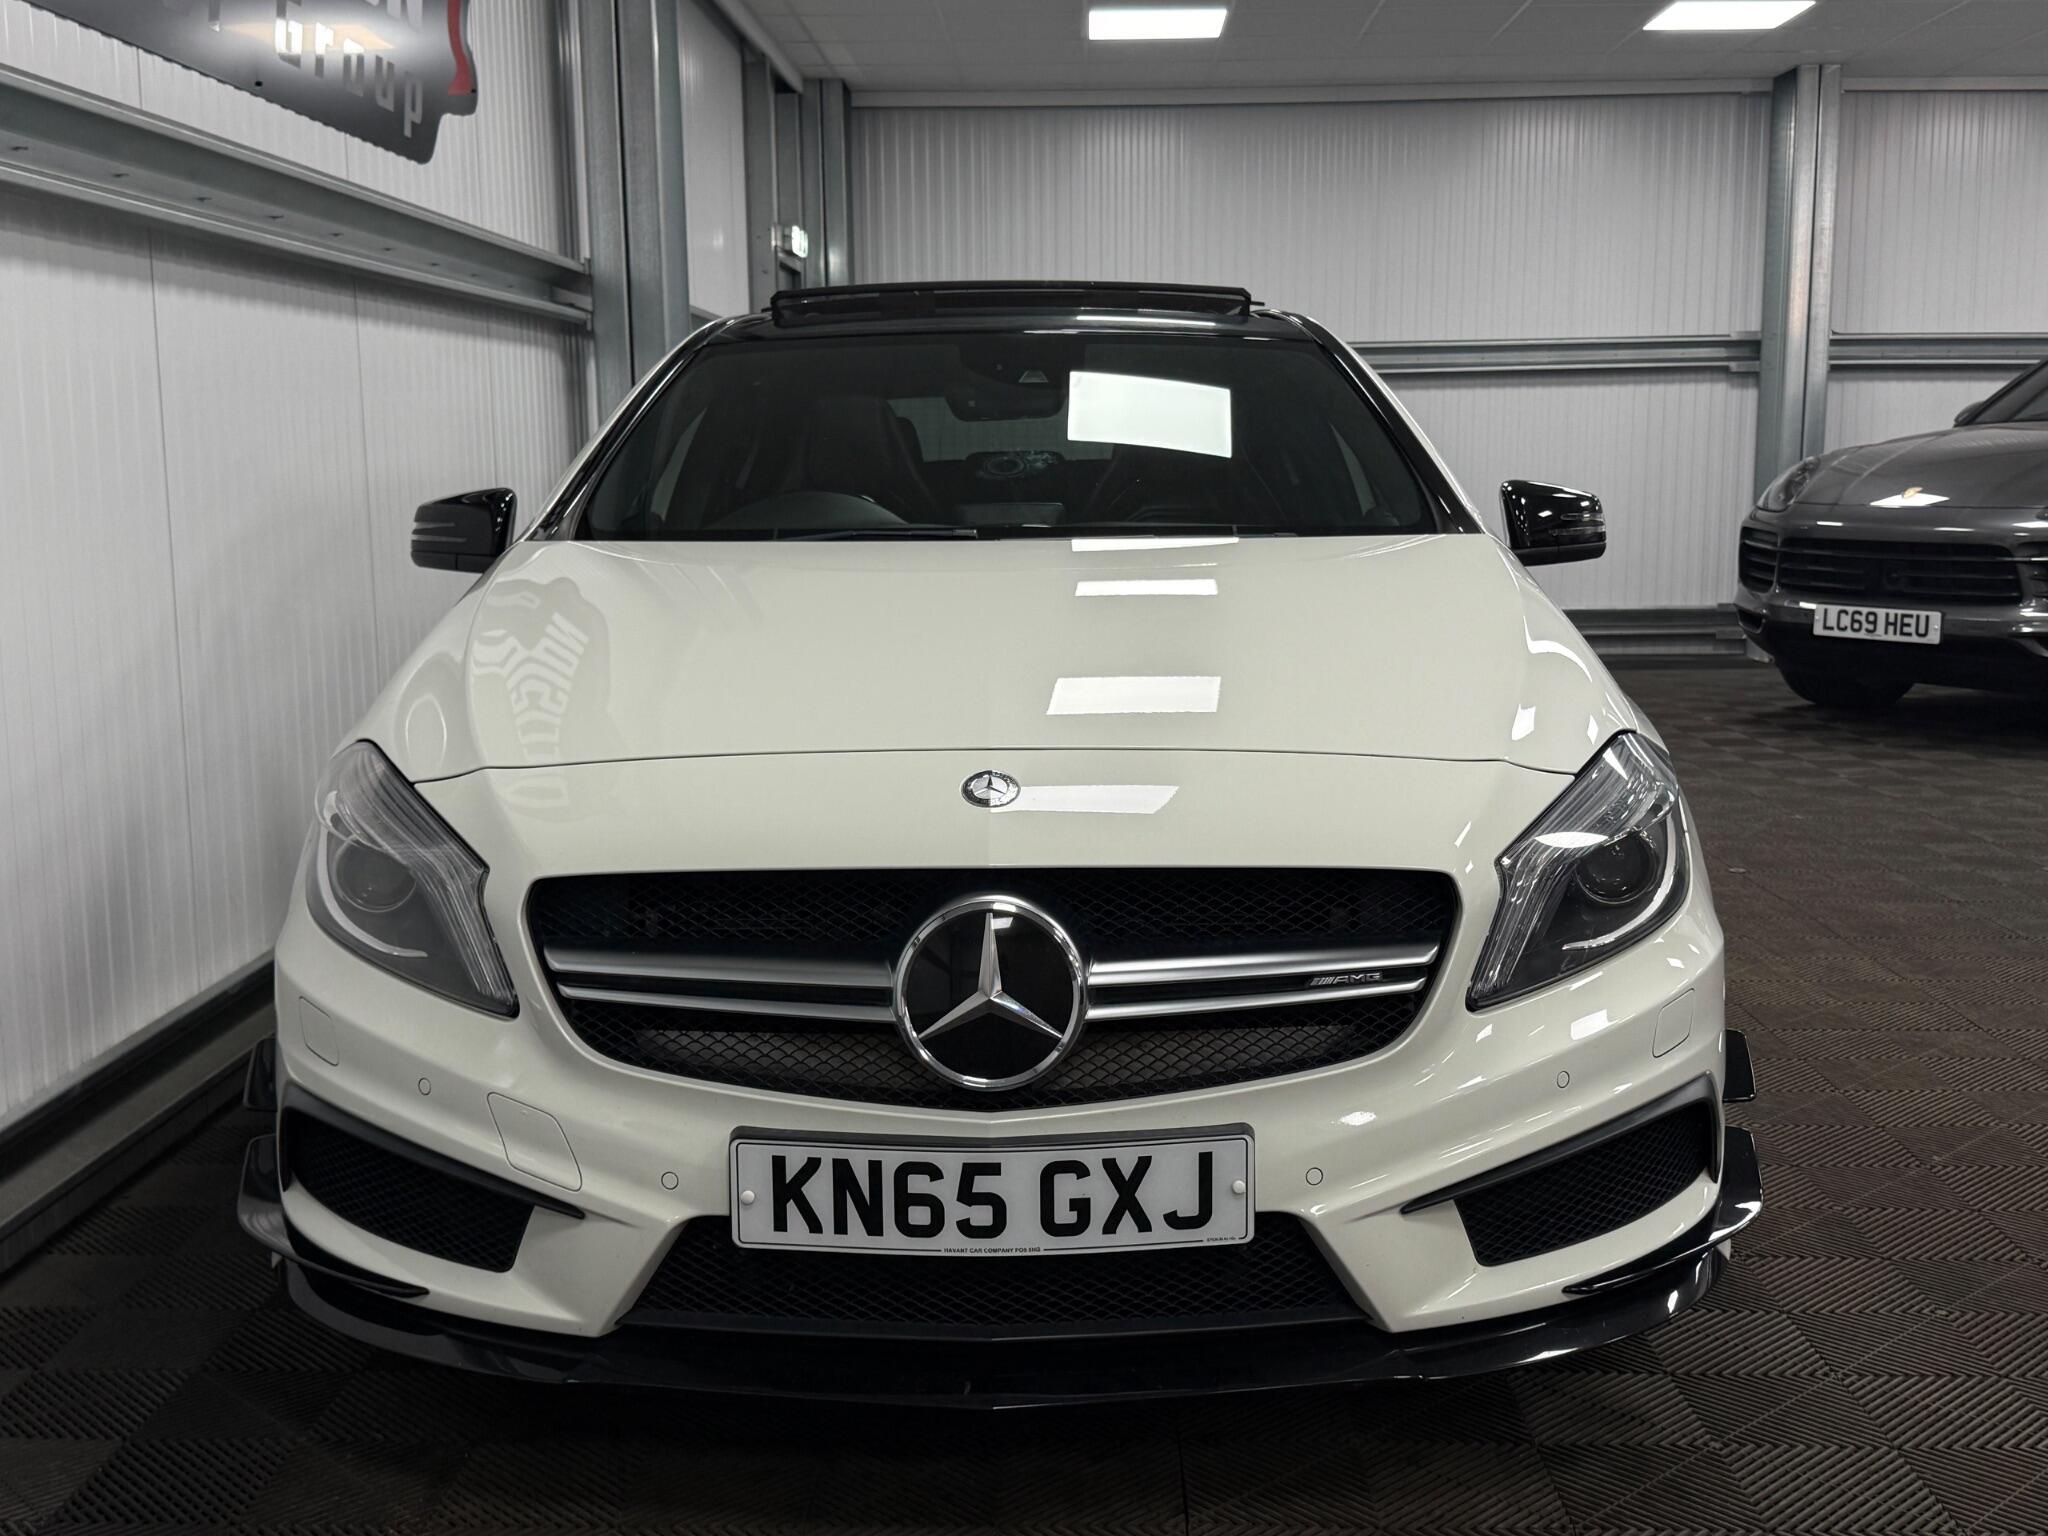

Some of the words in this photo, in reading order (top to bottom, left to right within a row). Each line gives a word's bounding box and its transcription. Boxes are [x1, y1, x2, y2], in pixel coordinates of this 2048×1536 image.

[1822, 608, 1878, 634] LC69
[1884, 612, 1930, 638] HEU
[1332, 972, 1383, 985] AMG
[772, 1155, 1007, 1239] KN65
[1039, 1151, 1214, 1237] GXJ
